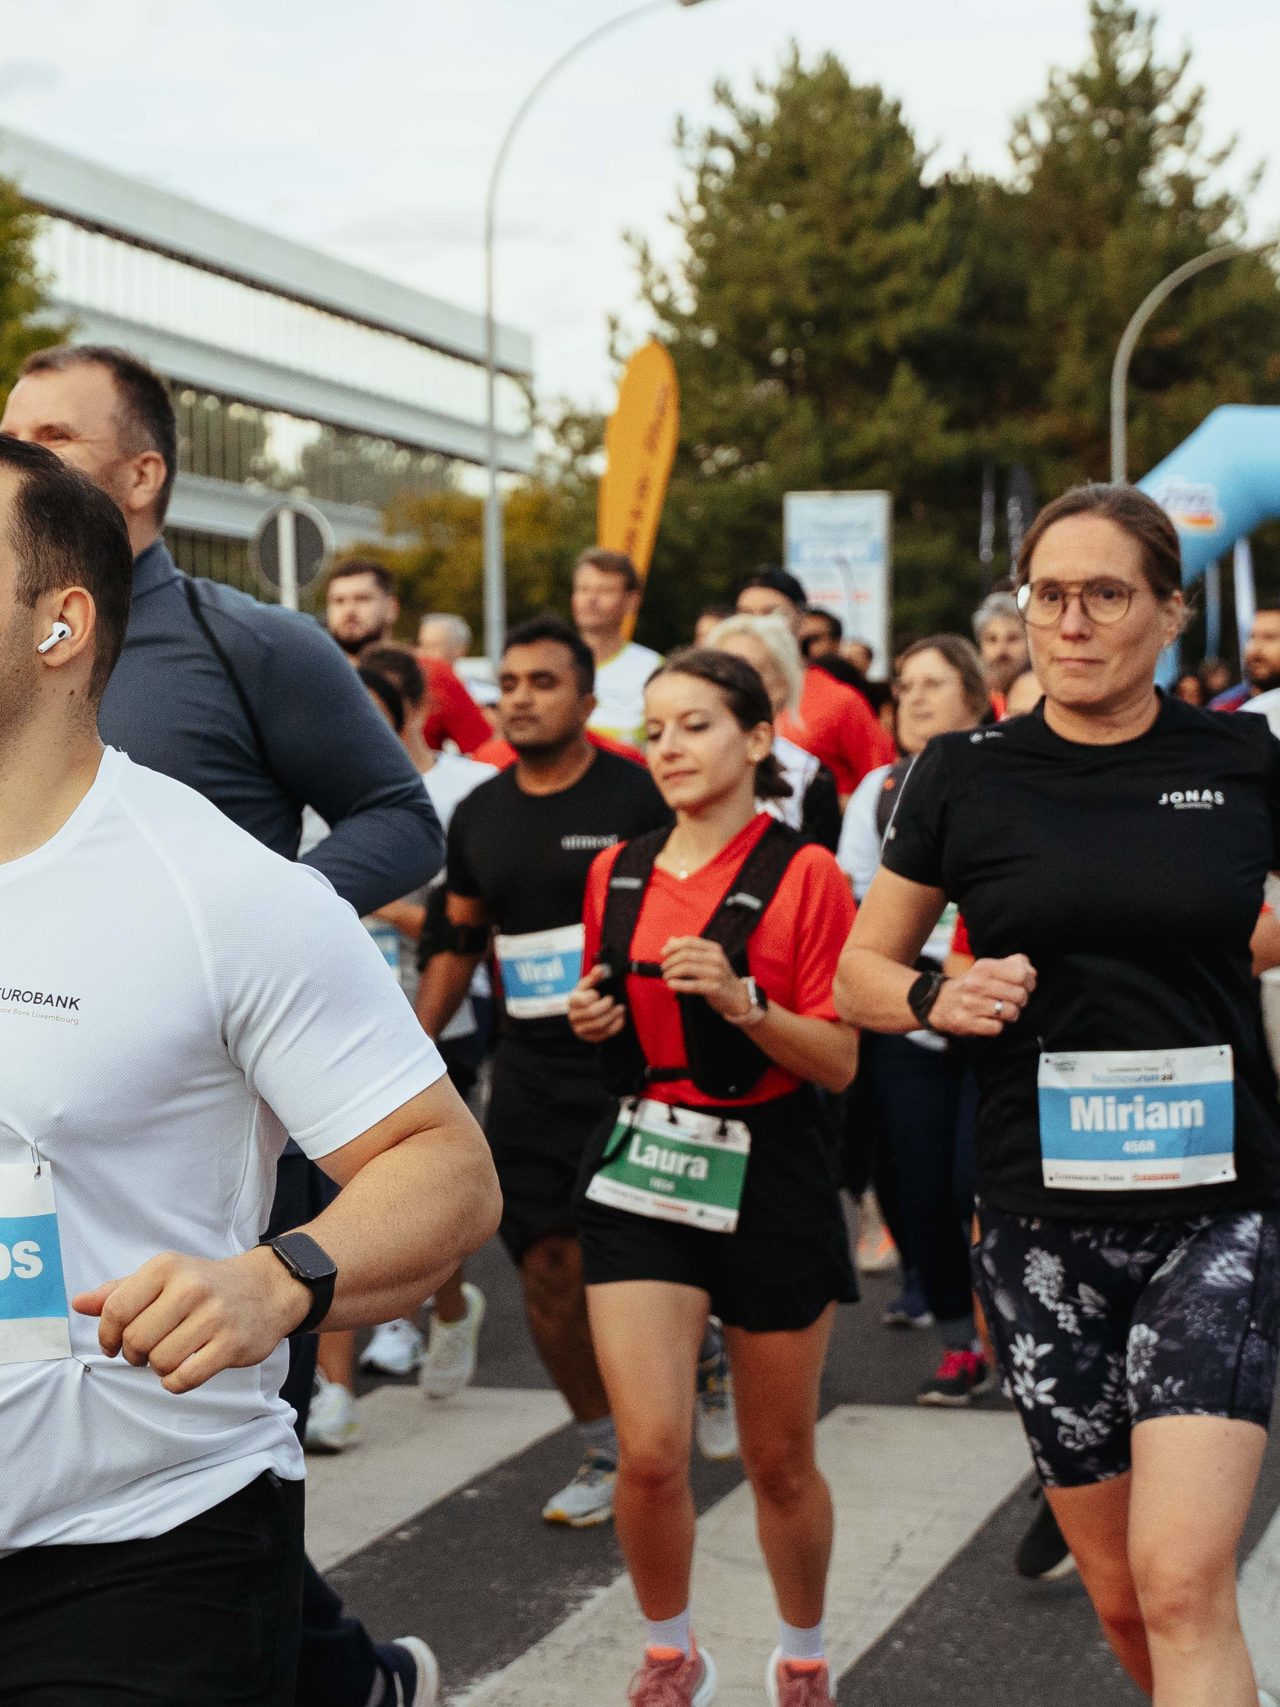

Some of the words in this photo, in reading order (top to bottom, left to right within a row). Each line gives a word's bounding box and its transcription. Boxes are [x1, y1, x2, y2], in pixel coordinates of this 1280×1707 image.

[1158, 789, 1225, 805] JONAS
[13, 1008, 30, 1016] Bank
[31, 1011, 80, 1025] Luxembourg
[1070, 1094, 1205, 1132] Miriam
[627, 1133, 709, 1181] Laura
